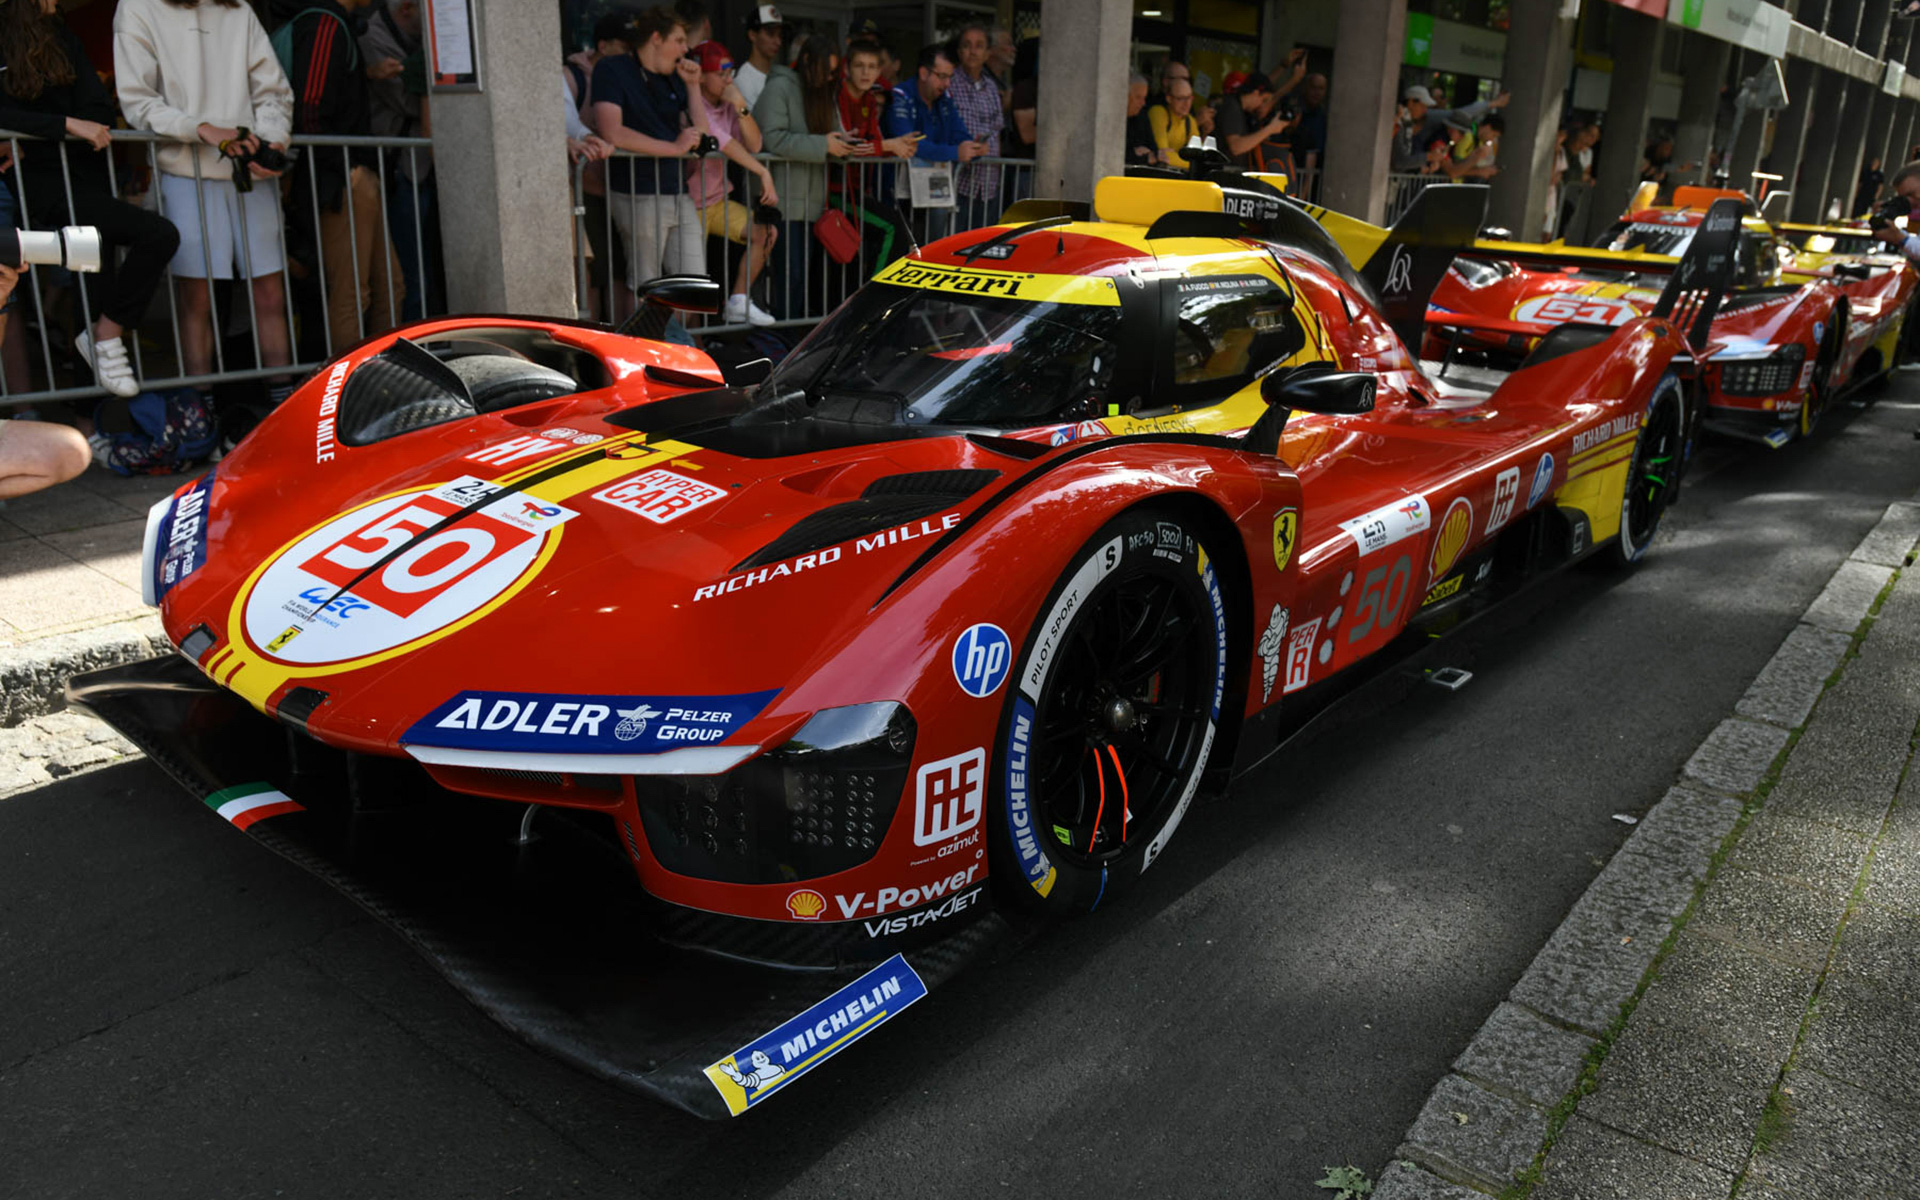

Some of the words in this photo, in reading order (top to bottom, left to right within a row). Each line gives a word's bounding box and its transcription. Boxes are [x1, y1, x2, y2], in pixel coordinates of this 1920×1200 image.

[882, 261, 1024, 296] Ferrari
[1539, 302, 1609, 325] 51
[319, 361, 350, 417] RICHARD
[316, 418, 335, 464] MILLE
[1573, 421, 1611, 455] RICHARD
[1613, 412, 1640, 434] MILLE
[604, 482, 692, 519] CAR
[638, 472, 718, 502] HYPER
[169, 489, 206, 548] ADLER
[323, 505, 496, 594] 50
[693, 547, 841, 602] RICHARD
[856, 513, 961, 554] MILLE
[1105, 545, 1117, 571] S
[298, 587, 371, 619] WEC
[1348, 554, 1411, 645] 50
[964, 627, 1007, 696] hp
[1031, 638, 1052, 686] PILOT
[1051, 590, 1079, 639] SPORT
[1211, 585, 1227, 710] MICHELIN
[435, 698, 611, 737] ADLER
[1010, 714, 1038, 861] MICHELIN
[937, 829, 979, 858] azimut
[835, 864, 979, 919] V-Power
[864, 888, 982, 938] VISTAJET
[780, 976, 901, 1063] MICHELIN
